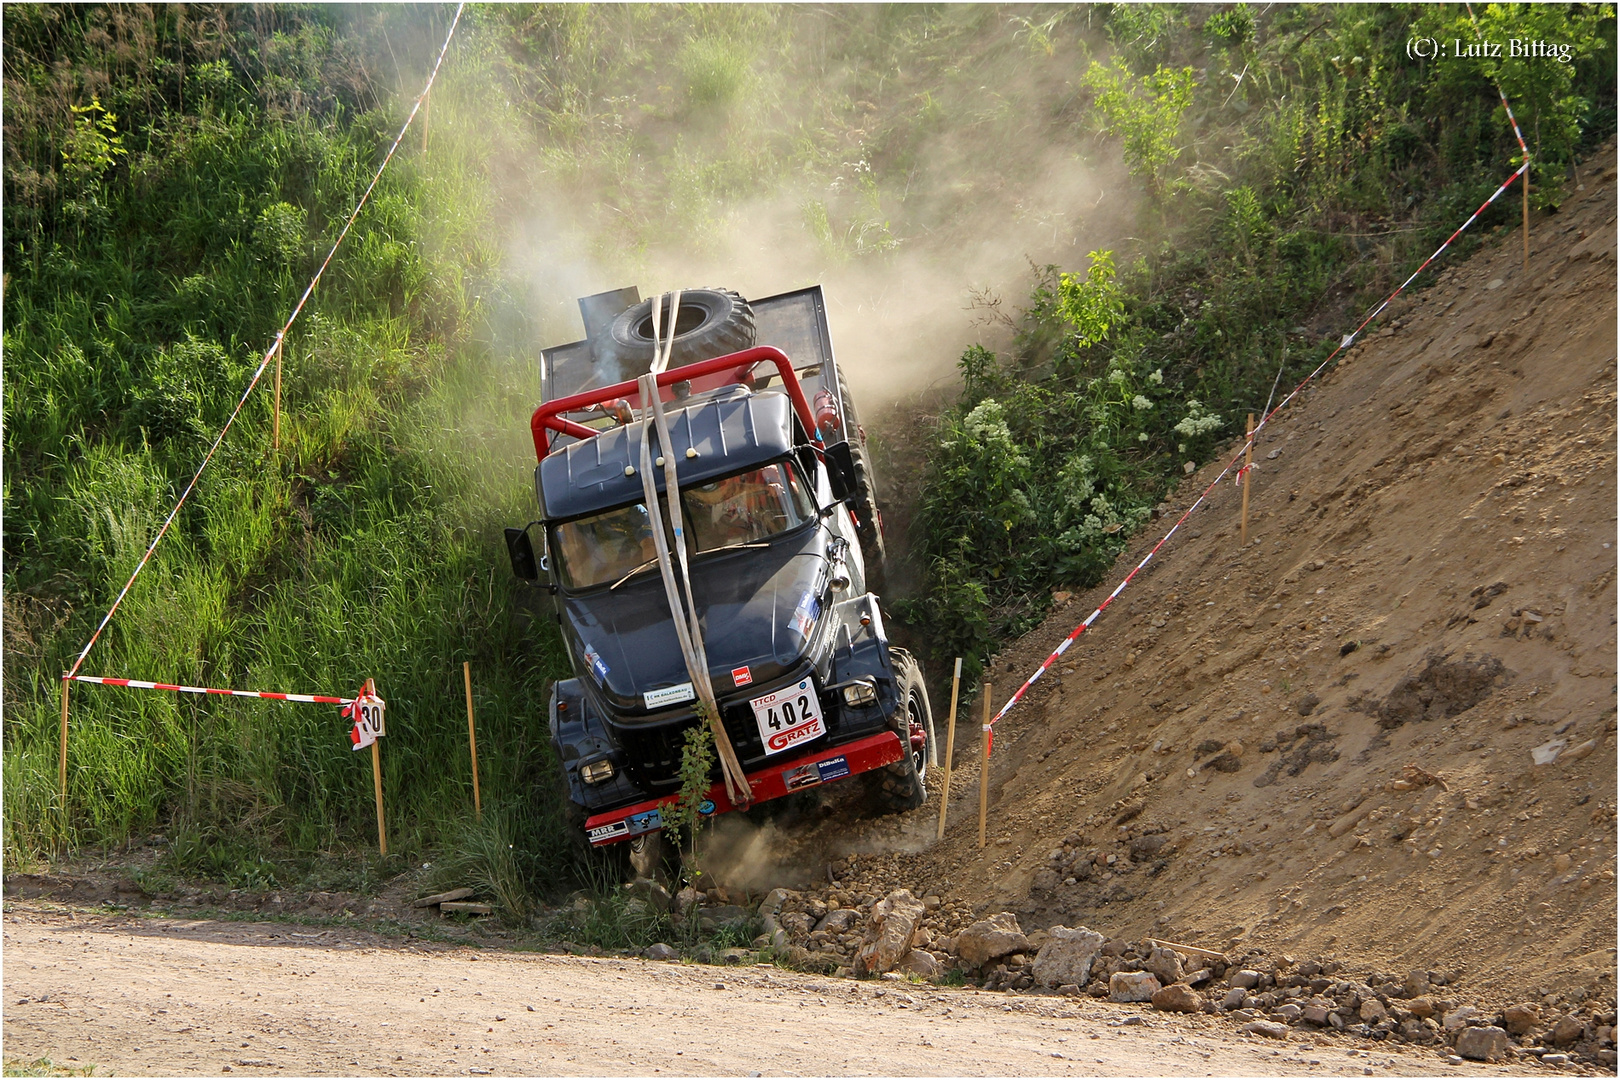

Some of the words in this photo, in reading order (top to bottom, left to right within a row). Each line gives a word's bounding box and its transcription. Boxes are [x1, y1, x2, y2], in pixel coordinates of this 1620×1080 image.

[753, 694, 776, 707] TTCD
[767, 695, 813, 731] 402
[768, 718, 821, 750] GRATZ
[591, 825, 616, 837] MRR
